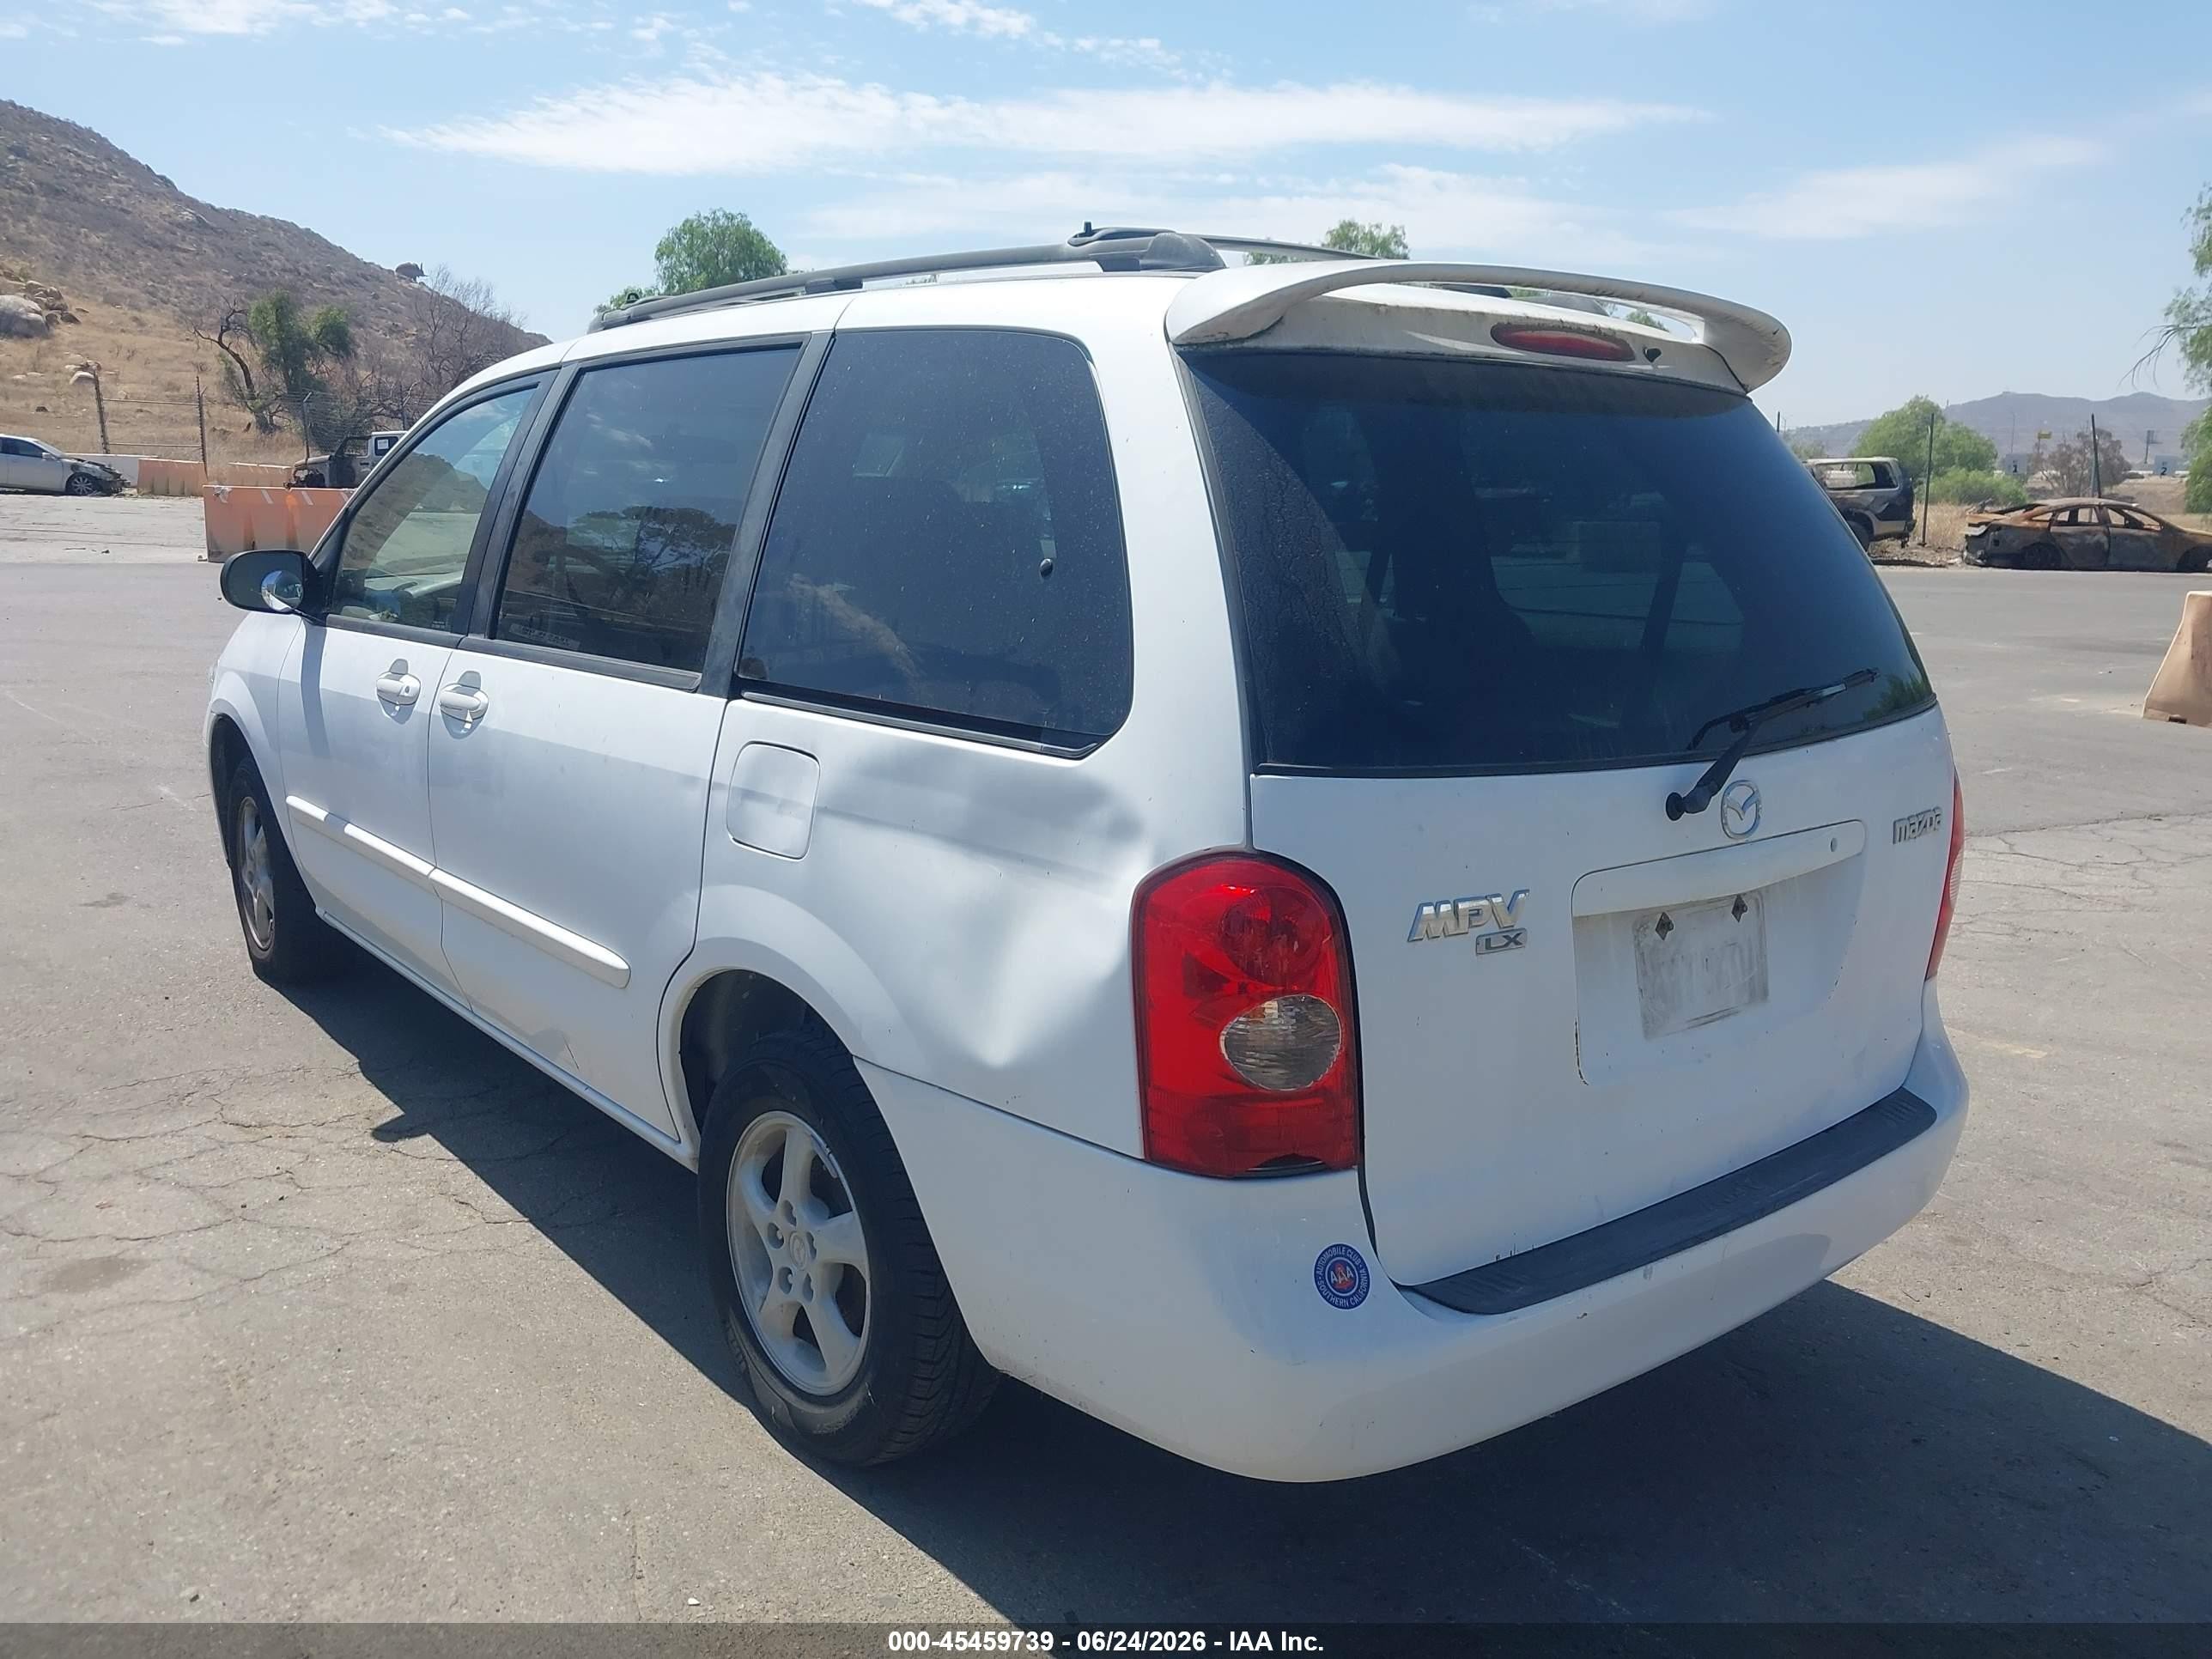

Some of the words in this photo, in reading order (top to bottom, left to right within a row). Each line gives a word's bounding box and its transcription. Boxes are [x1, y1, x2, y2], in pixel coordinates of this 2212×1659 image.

[1407, 889, 1530, 942] MPV
[1485, 932, 1523, 951] LX
[1316, 1245, 1346, 1276] AUTOMOBILE
[1346, 1249, 1362, 1266] CLUB
[1330, 1266, 1354, 1285] AAA
[1317, 1280, 1349, 1307] SOUTHERN
[1350, 1269, 1368, 1306] CALIFORNIA
